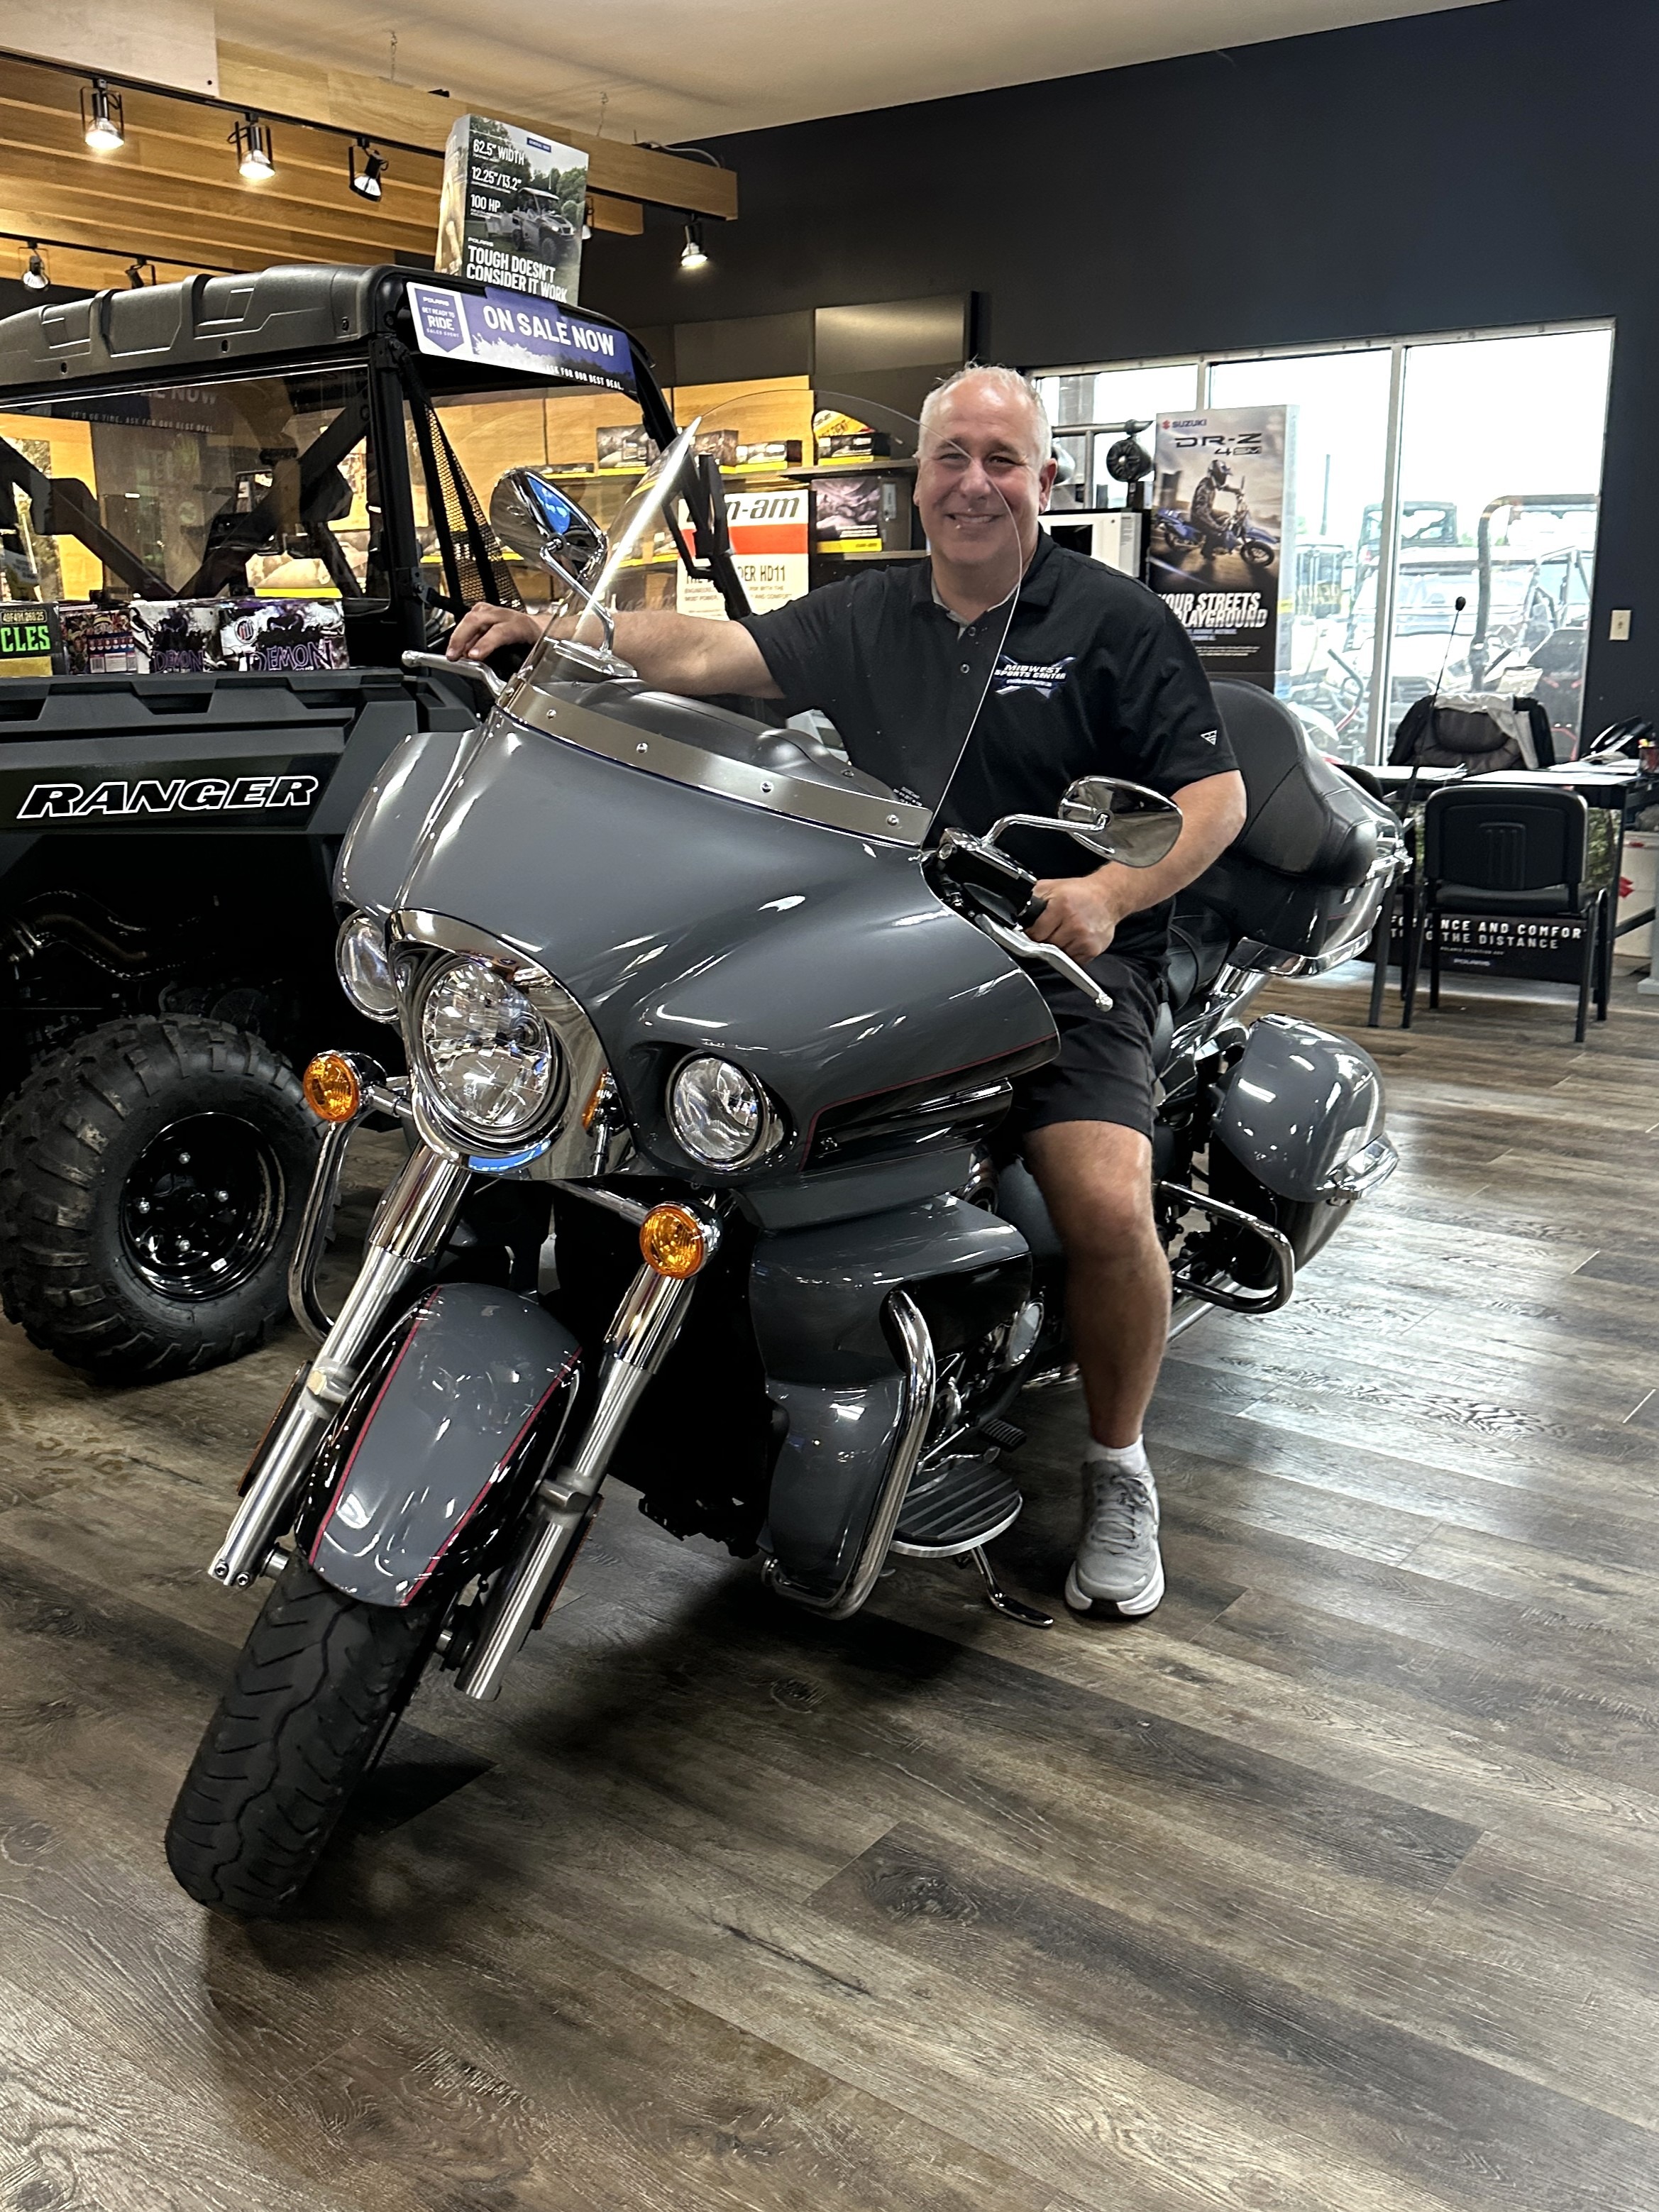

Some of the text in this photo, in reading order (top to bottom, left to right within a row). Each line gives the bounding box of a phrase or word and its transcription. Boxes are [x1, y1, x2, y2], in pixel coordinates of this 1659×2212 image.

[473, 139, 497, 155] 62.5"
[497, 145, 524, 165] WIDTH
[470, 194, 501, 212] 100 HP
[468, 245, 556, 283] TOUGH DOESN'T
[467, 263, 568, 304] CONSIDER IT WORK
[427, 315, 454, 331] RIDE
[483, 305, 614, 356] ON SALE NOW
[546, 364, 559, 375] ASK
[561, 368, 573, 378] FOR
[574, 370, 588, 381] OUR
[588, 374, 604, 385] BEST
[1172, 419, 1207, 428] SUZUKI
[1174, 433, 1262, 448] DR-Z
[1196, 592, 1261, 612] STREETS
[1, 625, 51, 652] CLES
[153, 649, 204, 673] DEMON
[245, 639, 335, 671] DEMON
[994, 669, 1031, 678] SPORTS
[1004, 664, 1062, 673] MIDWEST
[16, 775, 319, 819] RANGER
[1442, 932, 1470, 943] THE
[1479, 935, 1558, 949] DISTANCE
[1478, 922, 1509, 933] AND
[1517, 924, 1587, 939] COMFOR
